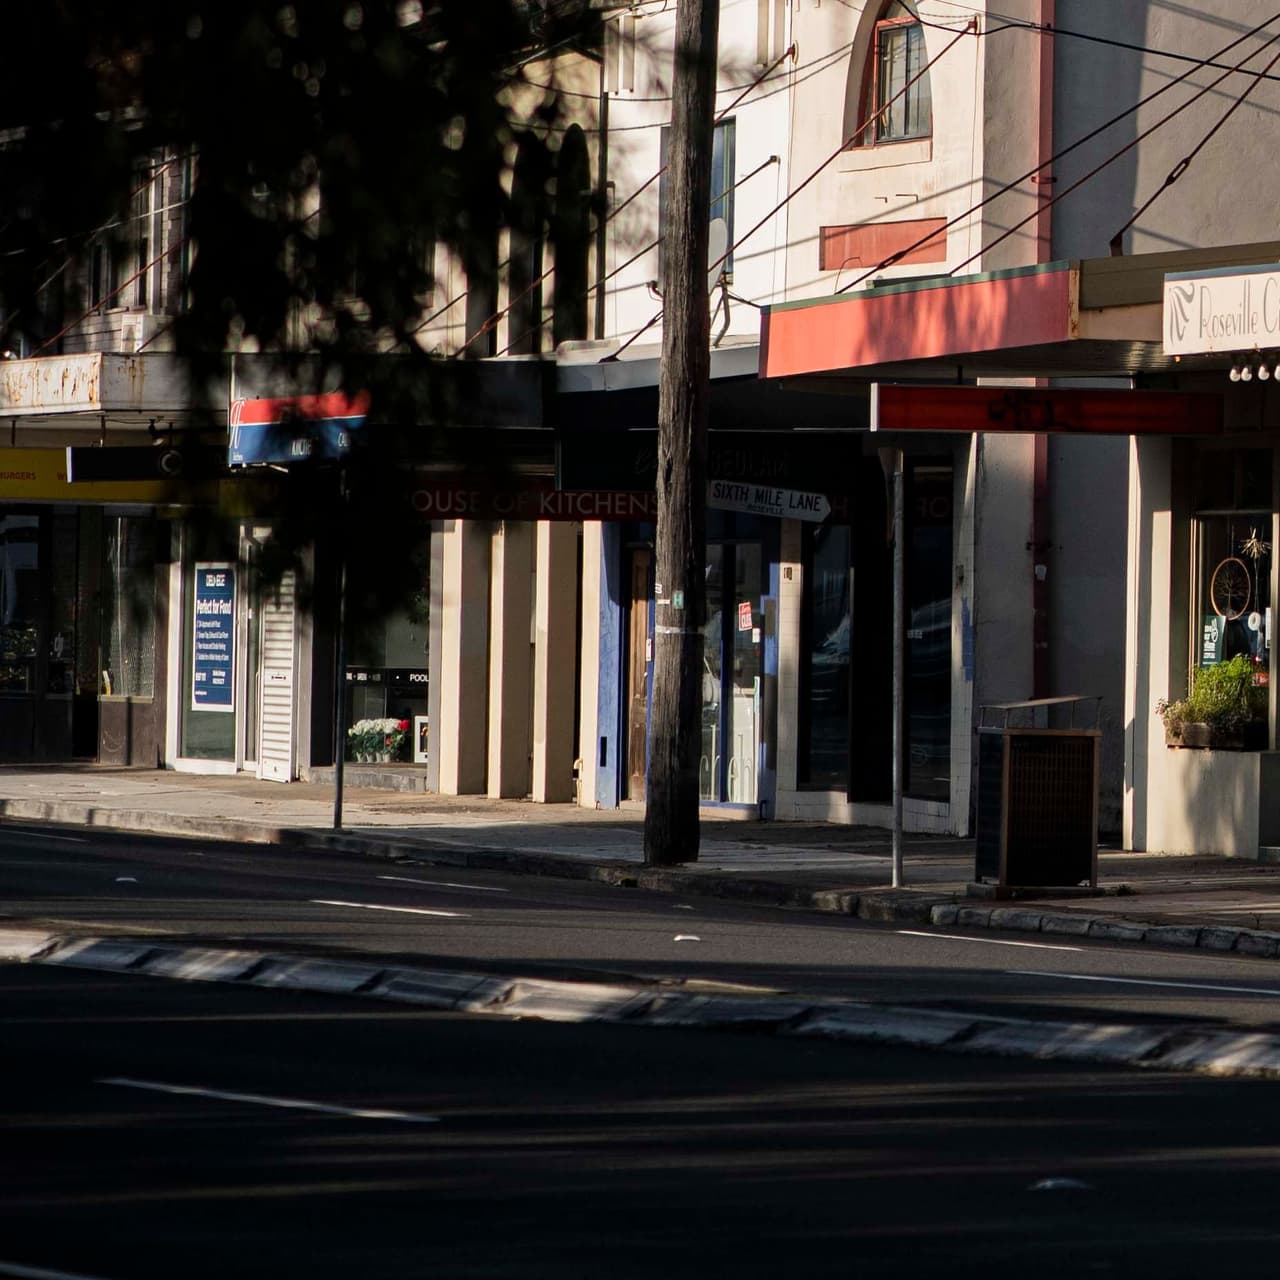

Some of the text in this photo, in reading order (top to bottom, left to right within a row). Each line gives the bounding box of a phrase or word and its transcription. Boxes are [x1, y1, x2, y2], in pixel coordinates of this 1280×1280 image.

[1199, 279, 1258, 338] Roseville
[403, 488, 480, 513] OUSE
[713, 482, 749, 502] SIXTH
[755, 488, 784, 507] MILE
[789, 493, 822, 512] LANE
